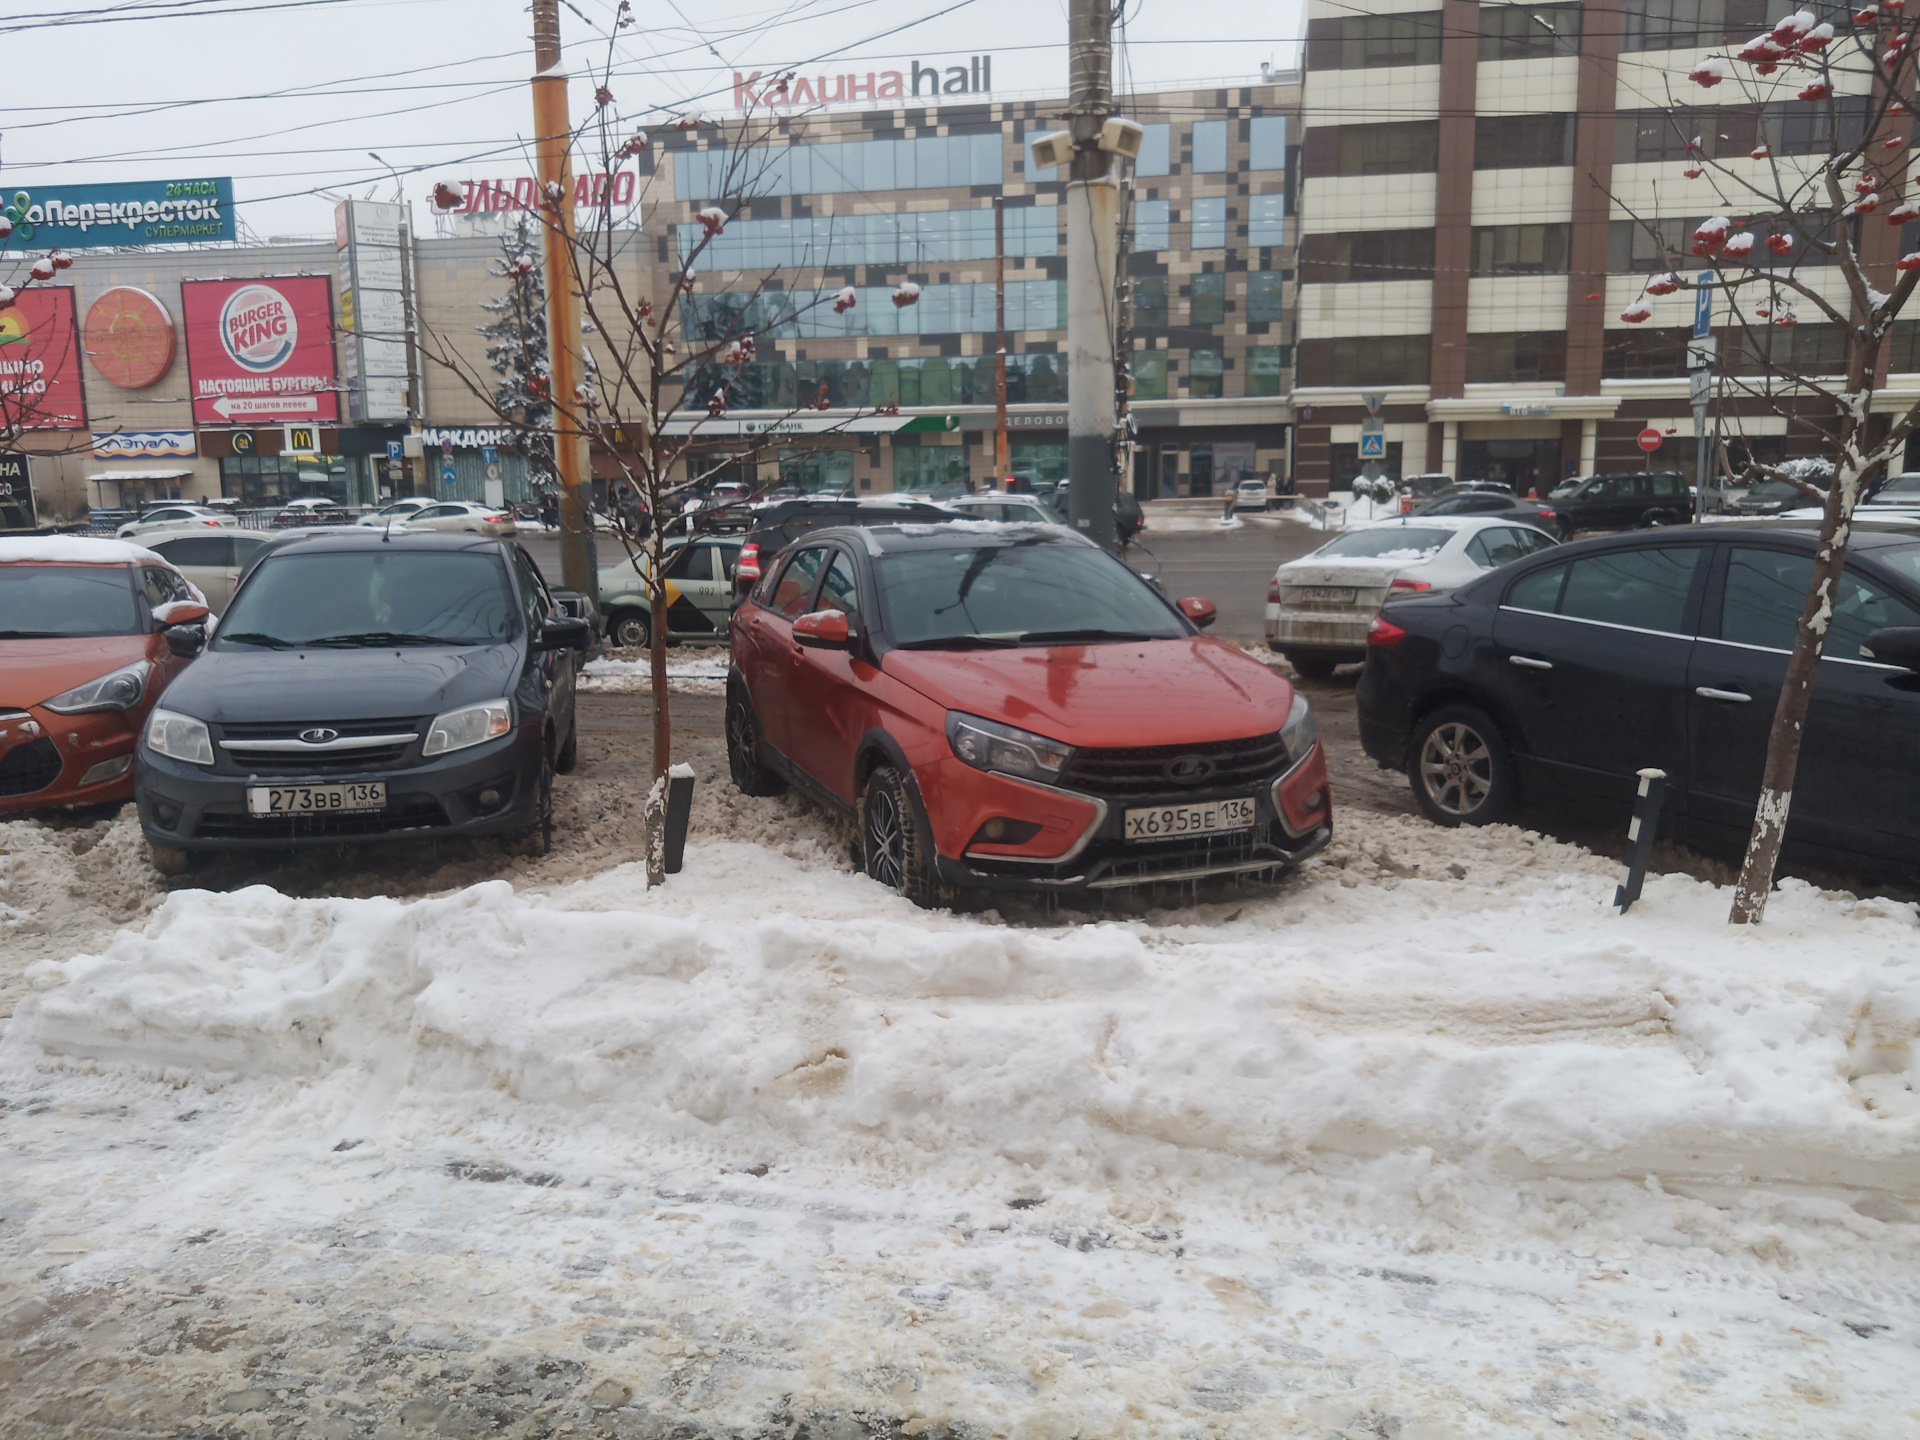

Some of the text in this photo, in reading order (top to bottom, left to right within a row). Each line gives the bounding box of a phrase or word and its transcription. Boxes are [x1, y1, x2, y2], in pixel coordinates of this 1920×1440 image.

[166, 181, 217, 197] 24 ЧАСА
[145, 222, 223, 238] СУПЕРМАРКЕТ
[229, 301, 284, 334] BURGER
[233, 315, 288, 356] KING
[198, 377, 271, 394] НАСТОЯЩИЕ
[230, 401, 308, 410] на 20 шагов левее
[758, 423, 803, 431] СБЕРБАНК
[1005, 416, 1069, 427] ДЕЛОВО
[269, 785, 380, 811] 273ВВ 136
[1132, 801, 1249, 835] Х695ВЕ 136
